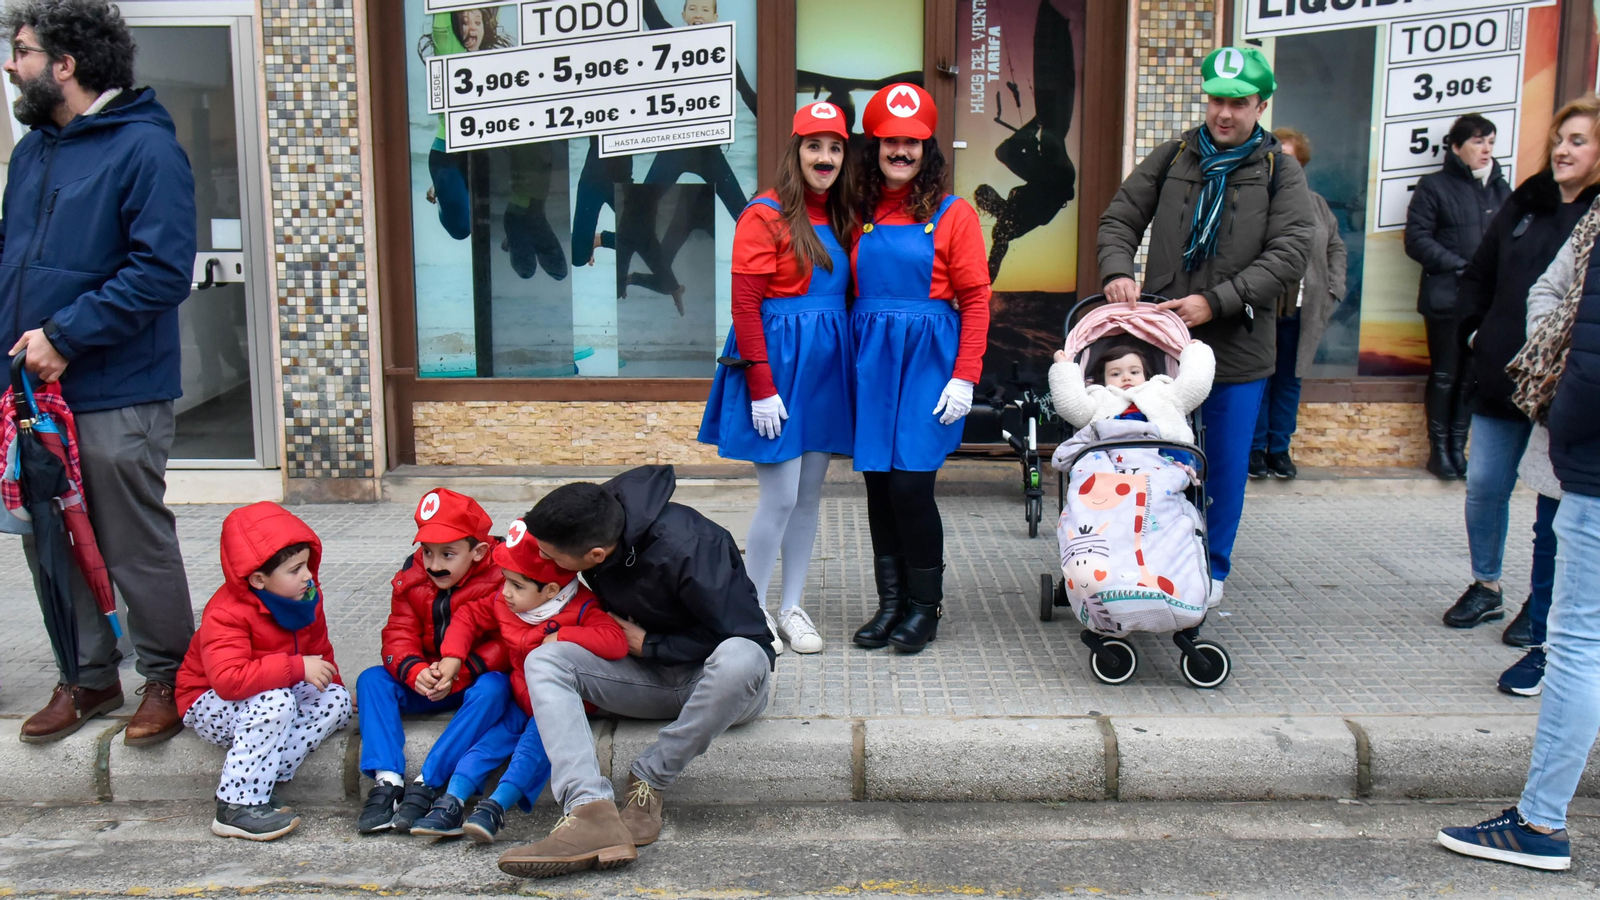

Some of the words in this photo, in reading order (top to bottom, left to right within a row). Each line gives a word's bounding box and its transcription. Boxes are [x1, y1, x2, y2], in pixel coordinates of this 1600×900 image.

[532, 0, 628, 35] TODO
[971, 0, 987, 41] VIENT
[1402, 18, 1497, 55] TODO
[971, 44, 985, 70] DEL
[987, 26, 1001, 82] TARIFA
[1223, 51, 1238, 74] L
[454, 68, 530, 97] 3,90€
[553, 55, 629, 85] 5,90€
[652, 43, 726, 73] 7,90€
[889, 91, 917, 111] M
[970, 74, 985, 113] HIJOS
[1413, 73, 1492, 103] 3,90€
[460, 116, 520, 139] 9,90€
[545, 106, 619, 129] 12,90€
[646, 93, 721, 116] 15,90€
[815, 106, 832, 115] M
[641, 134, 671, 144] AGOTAR
[673, 128, 725, 140] EXISTENCIAS
[423, 499, 435, 514] M
[508, 525, 521, 542] M
